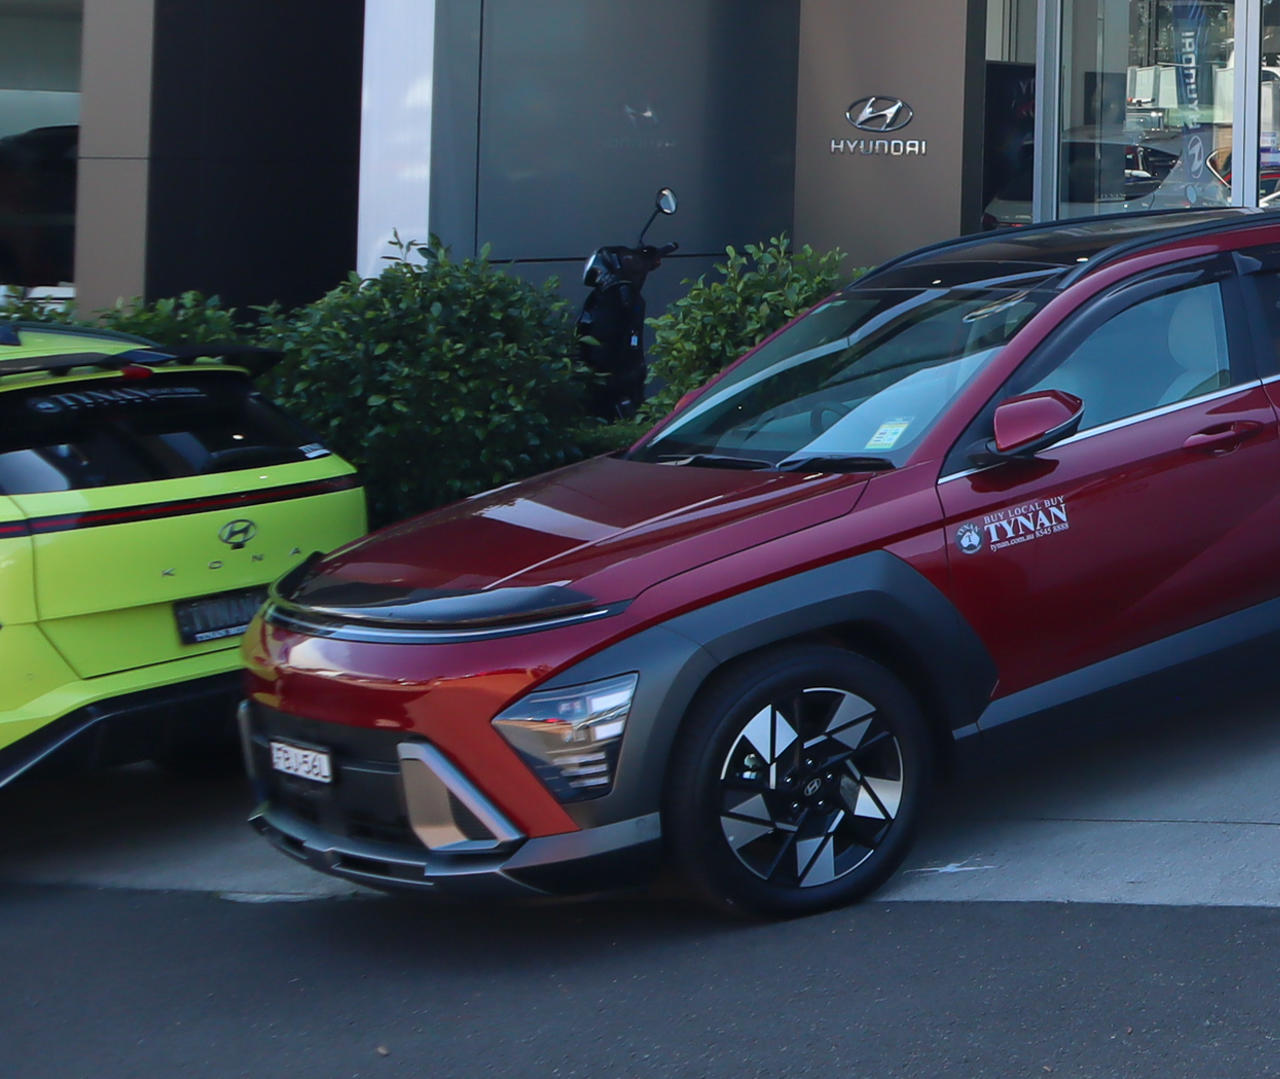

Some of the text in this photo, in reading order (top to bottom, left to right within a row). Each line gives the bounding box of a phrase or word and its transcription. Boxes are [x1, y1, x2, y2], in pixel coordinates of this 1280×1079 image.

[831, 139, 927, 155] HYUNDAI
[984, 495, 1065, 525] BUY LOCAL BUY
[984, 503, 1068, 544] TYNAN
